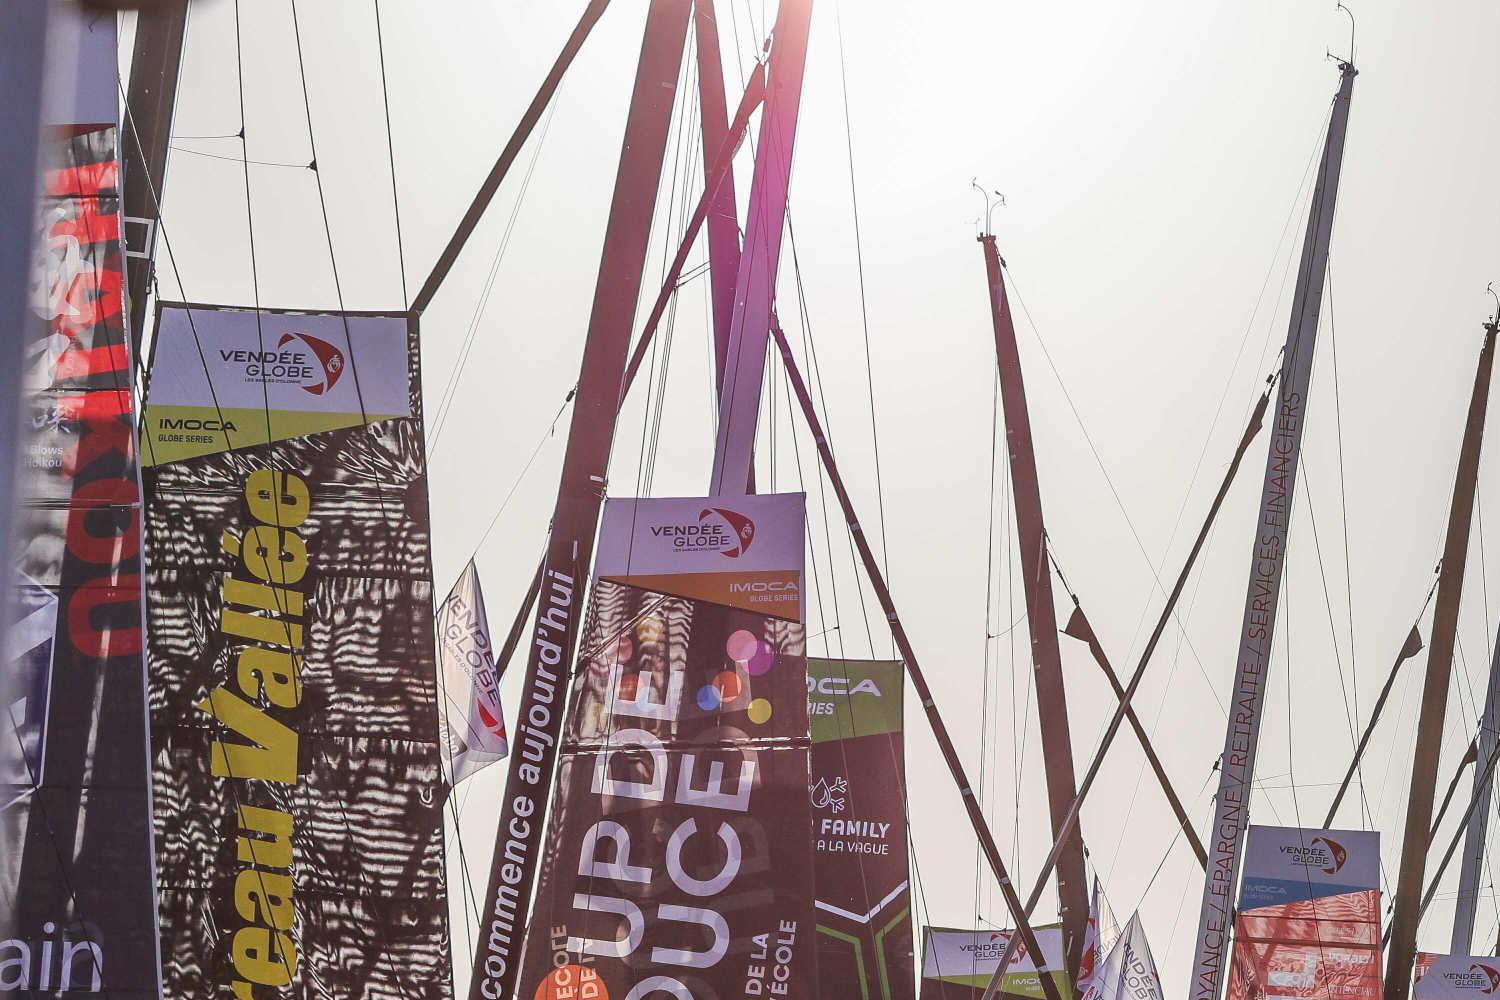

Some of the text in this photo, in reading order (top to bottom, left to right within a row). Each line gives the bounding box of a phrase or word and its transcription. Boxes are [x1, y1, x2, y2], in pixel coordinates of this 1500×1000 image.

[219, 349, 307, 365] VENDÉE
[246, 365, 314, 379] GLOBE
[159, 418, 238, 432] IMOCA
[158, 434, 214, 444] GLOBE SERIES
[1249, 390, 1300, 640] SERVICES FINANCIERS
[651, 523, 723, 536] VENDÉE
[674, 535, 730, 547] GLOBE
[730, 581, 799, 592] IMOCA
[200, 467, 310, 785] Vallée
[1230, 661, 1262, 768] RETRAITE
[591, 664, 685, 802] DE
[481, 795, 535, 999] commence
[518, 570, 575, 785] aujourd'hui
[820, 818, 892, 839] FAMILY
[829, 841, 845, 852] LA
[847, 841, 890, 855] VAGUE
[1211, 788, 1243, 897] ÉPARGNE
[1292, 855, 1330, 865] GLOBE
[750, 933, 769, 960] LA
[745, 965, 765, 996] DE
